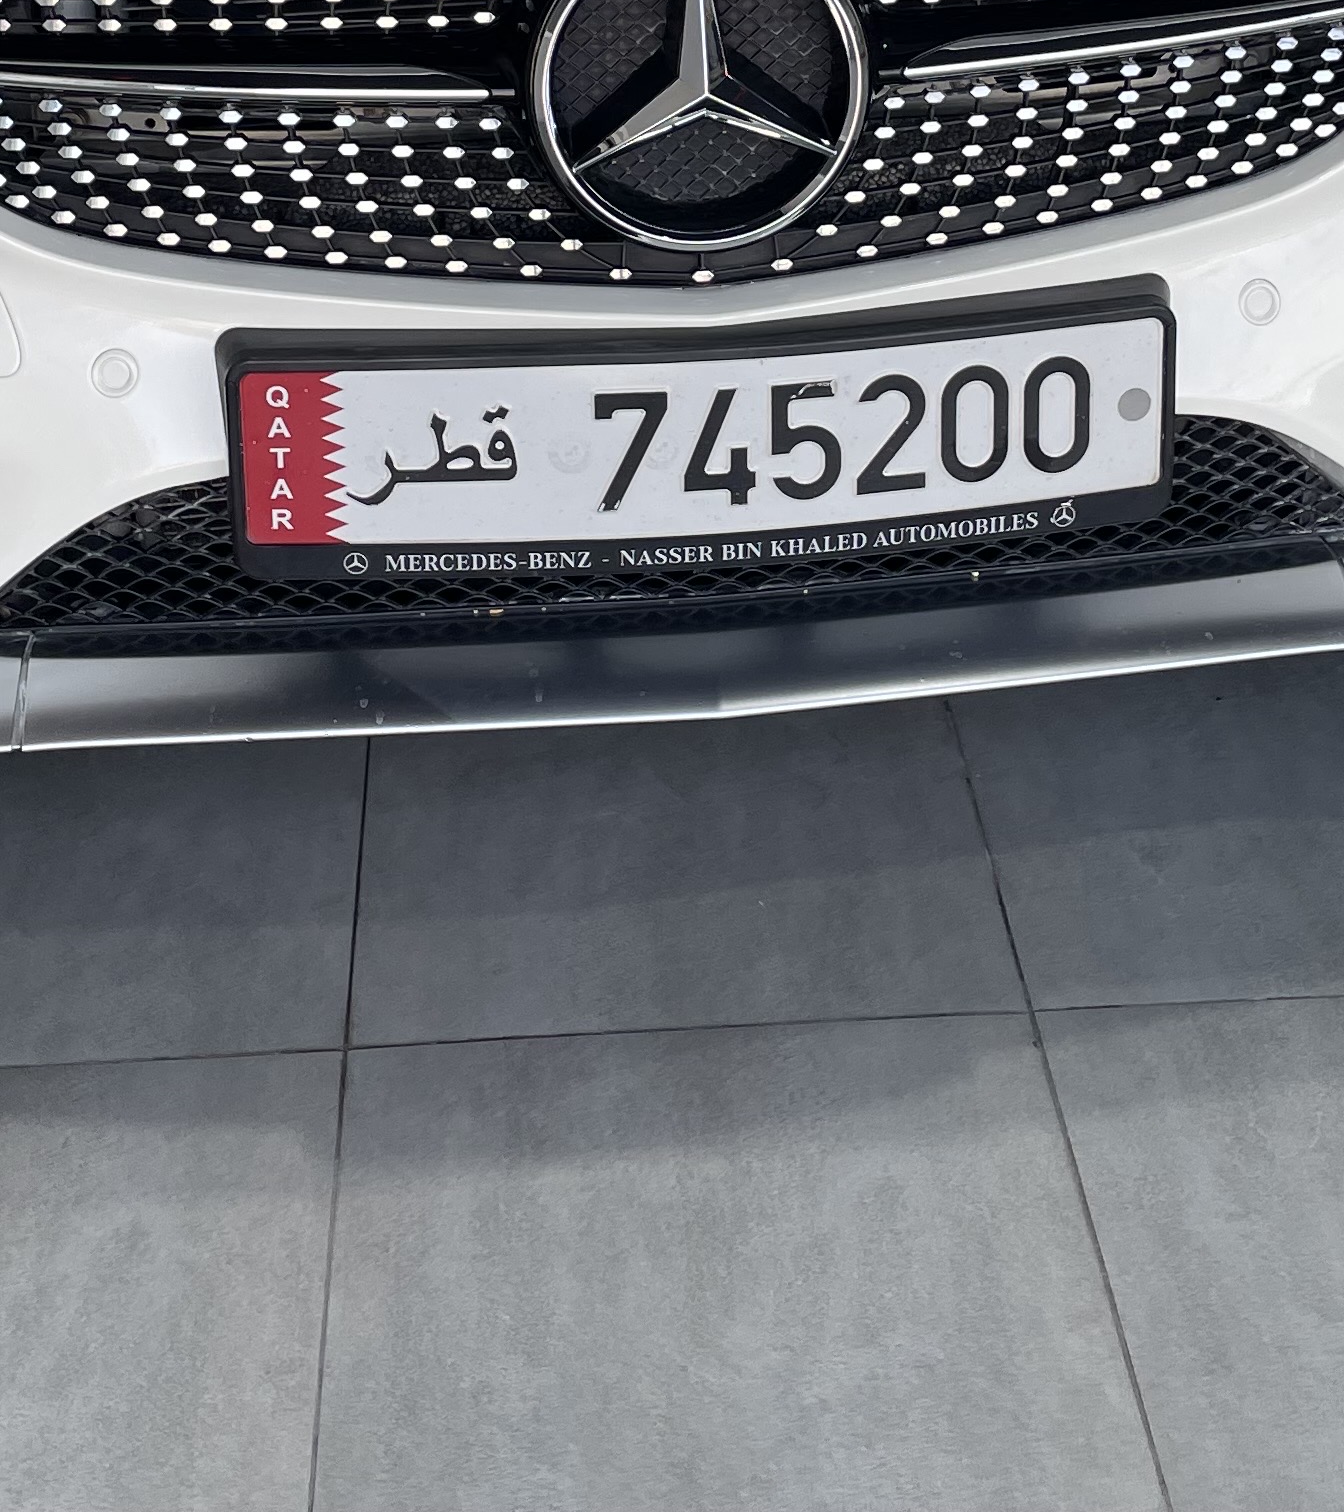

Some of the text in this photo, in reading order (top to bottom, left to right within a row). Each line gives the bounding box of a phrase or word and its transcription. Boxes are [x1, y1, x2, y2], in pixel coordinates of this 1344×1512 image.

[264, 385, 295, 531] QATAR
[345, 404, 519, 506] قطر
[593, 355, 1092, 512] 745200
[384, 550, 593, 573] MERCEDES-BENZ
[619, 544, 713, 567] NASSER
[721, 541, 763, 562] BIN
[770, 532, 868, 557] KHALED
[872, 511, 1040, 548] AUTOMOBILES
